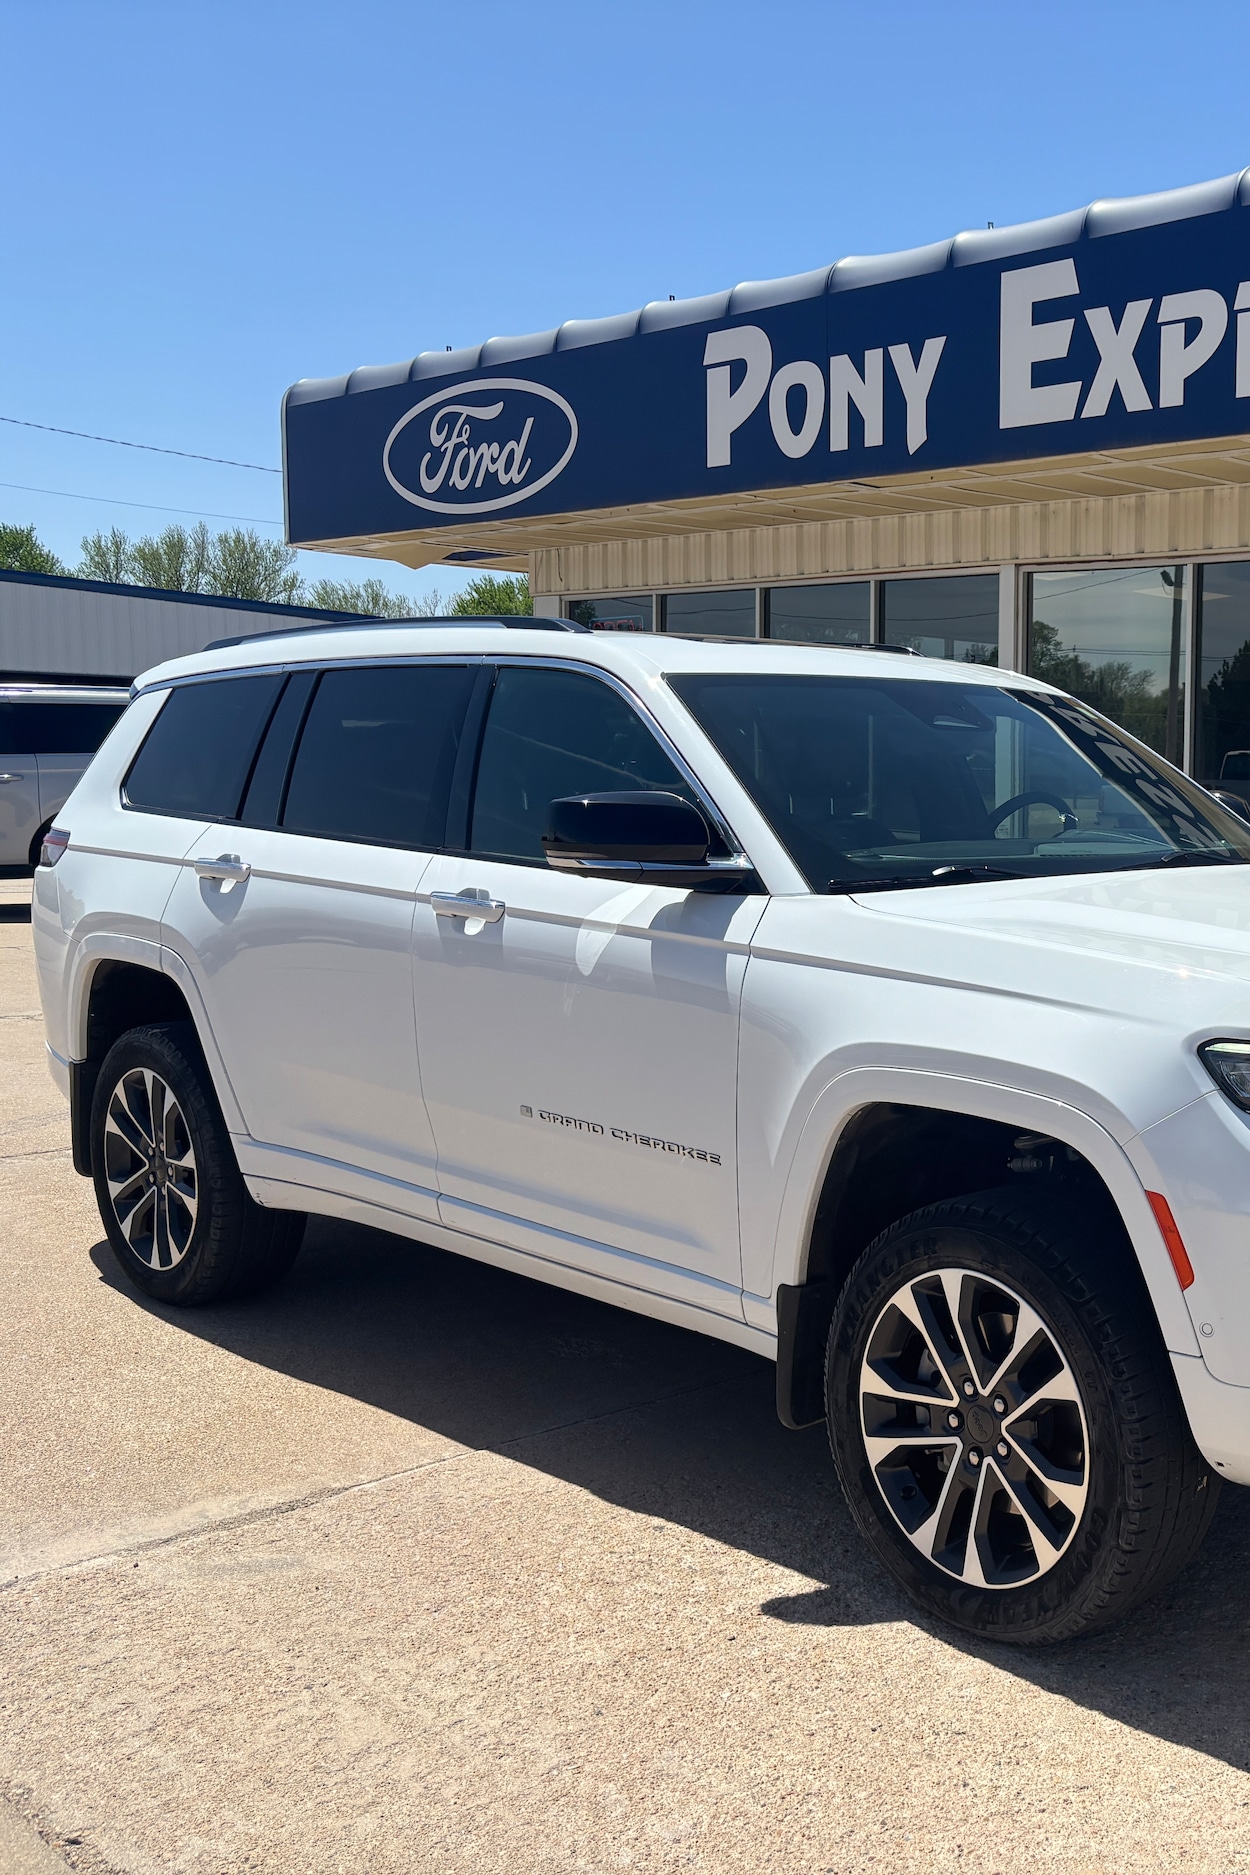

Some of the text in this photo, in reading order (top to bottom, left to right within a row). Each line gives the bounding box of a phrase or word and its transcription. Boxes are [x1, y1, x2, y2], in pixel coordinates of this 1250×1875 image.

[703, 325, 948, 468] PONY
[419, 400, 535, 494] Ford
[538, 1109, 722, 1167] GRAND CHEROKEE
